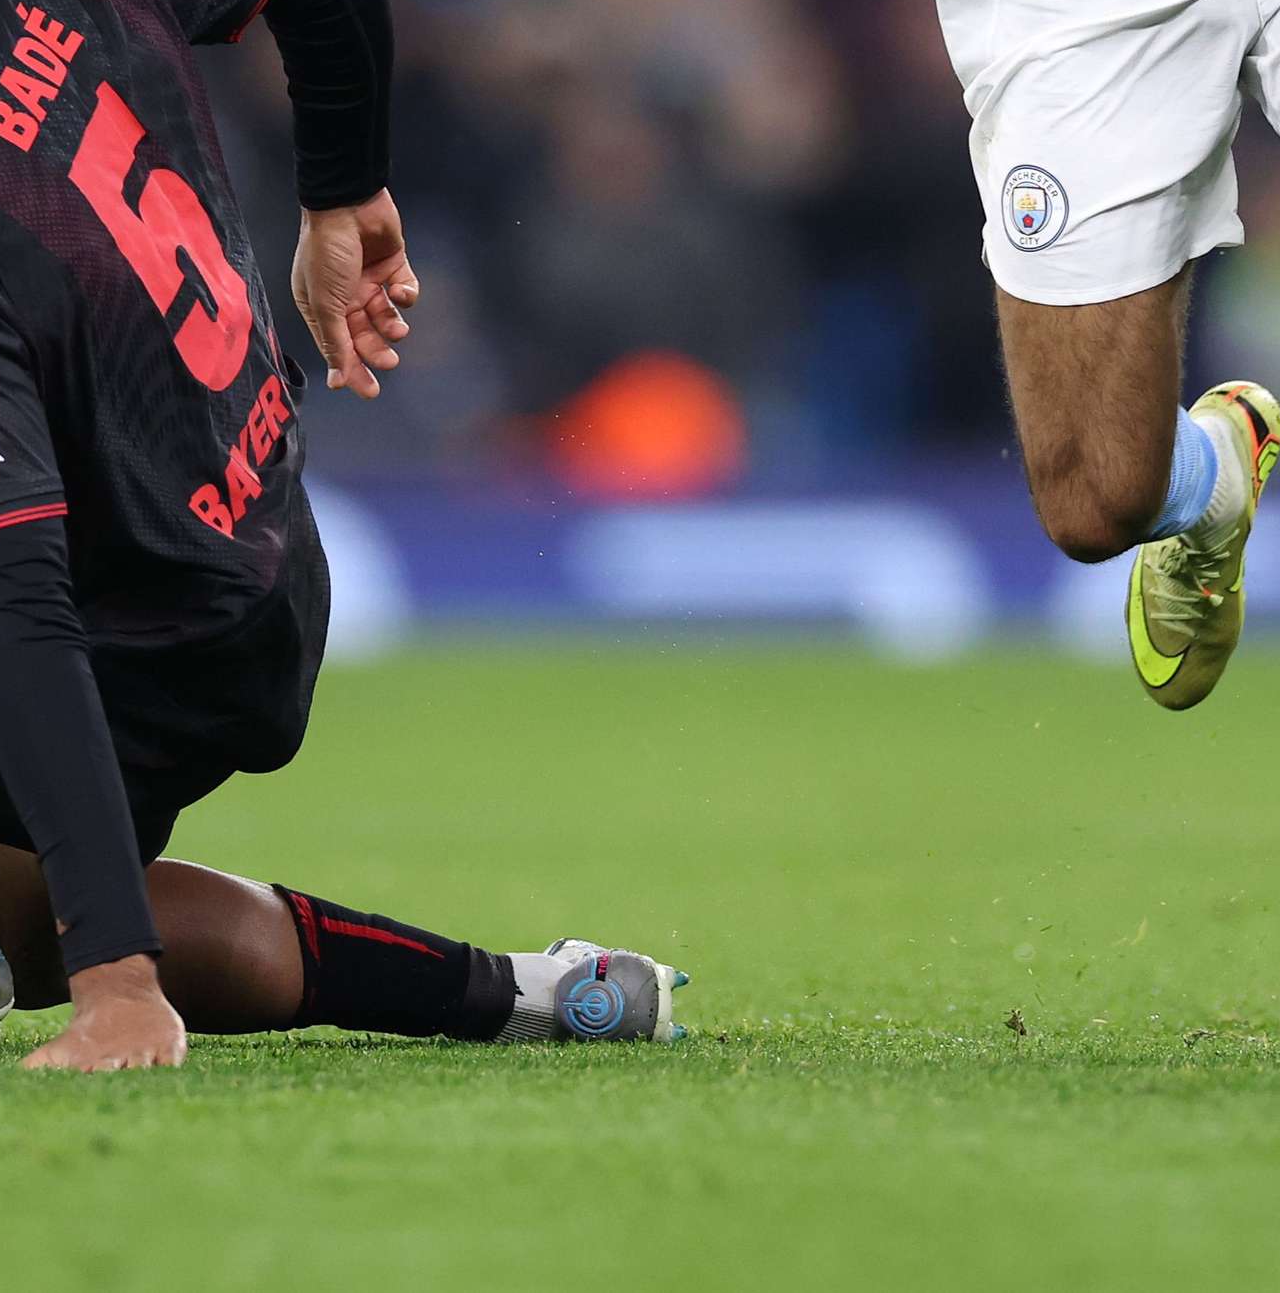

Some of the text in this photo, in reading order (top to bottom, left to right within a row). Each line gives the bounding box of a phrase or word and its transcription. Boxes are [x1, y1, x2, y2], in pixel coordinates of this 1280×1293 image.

[1006, 171, 1059, 198] MANCHESTER
[69, 80, 252, 391] 5
[1019, 237, 1040, 246] CITY
[188, 374, 290, 539] BAYER
